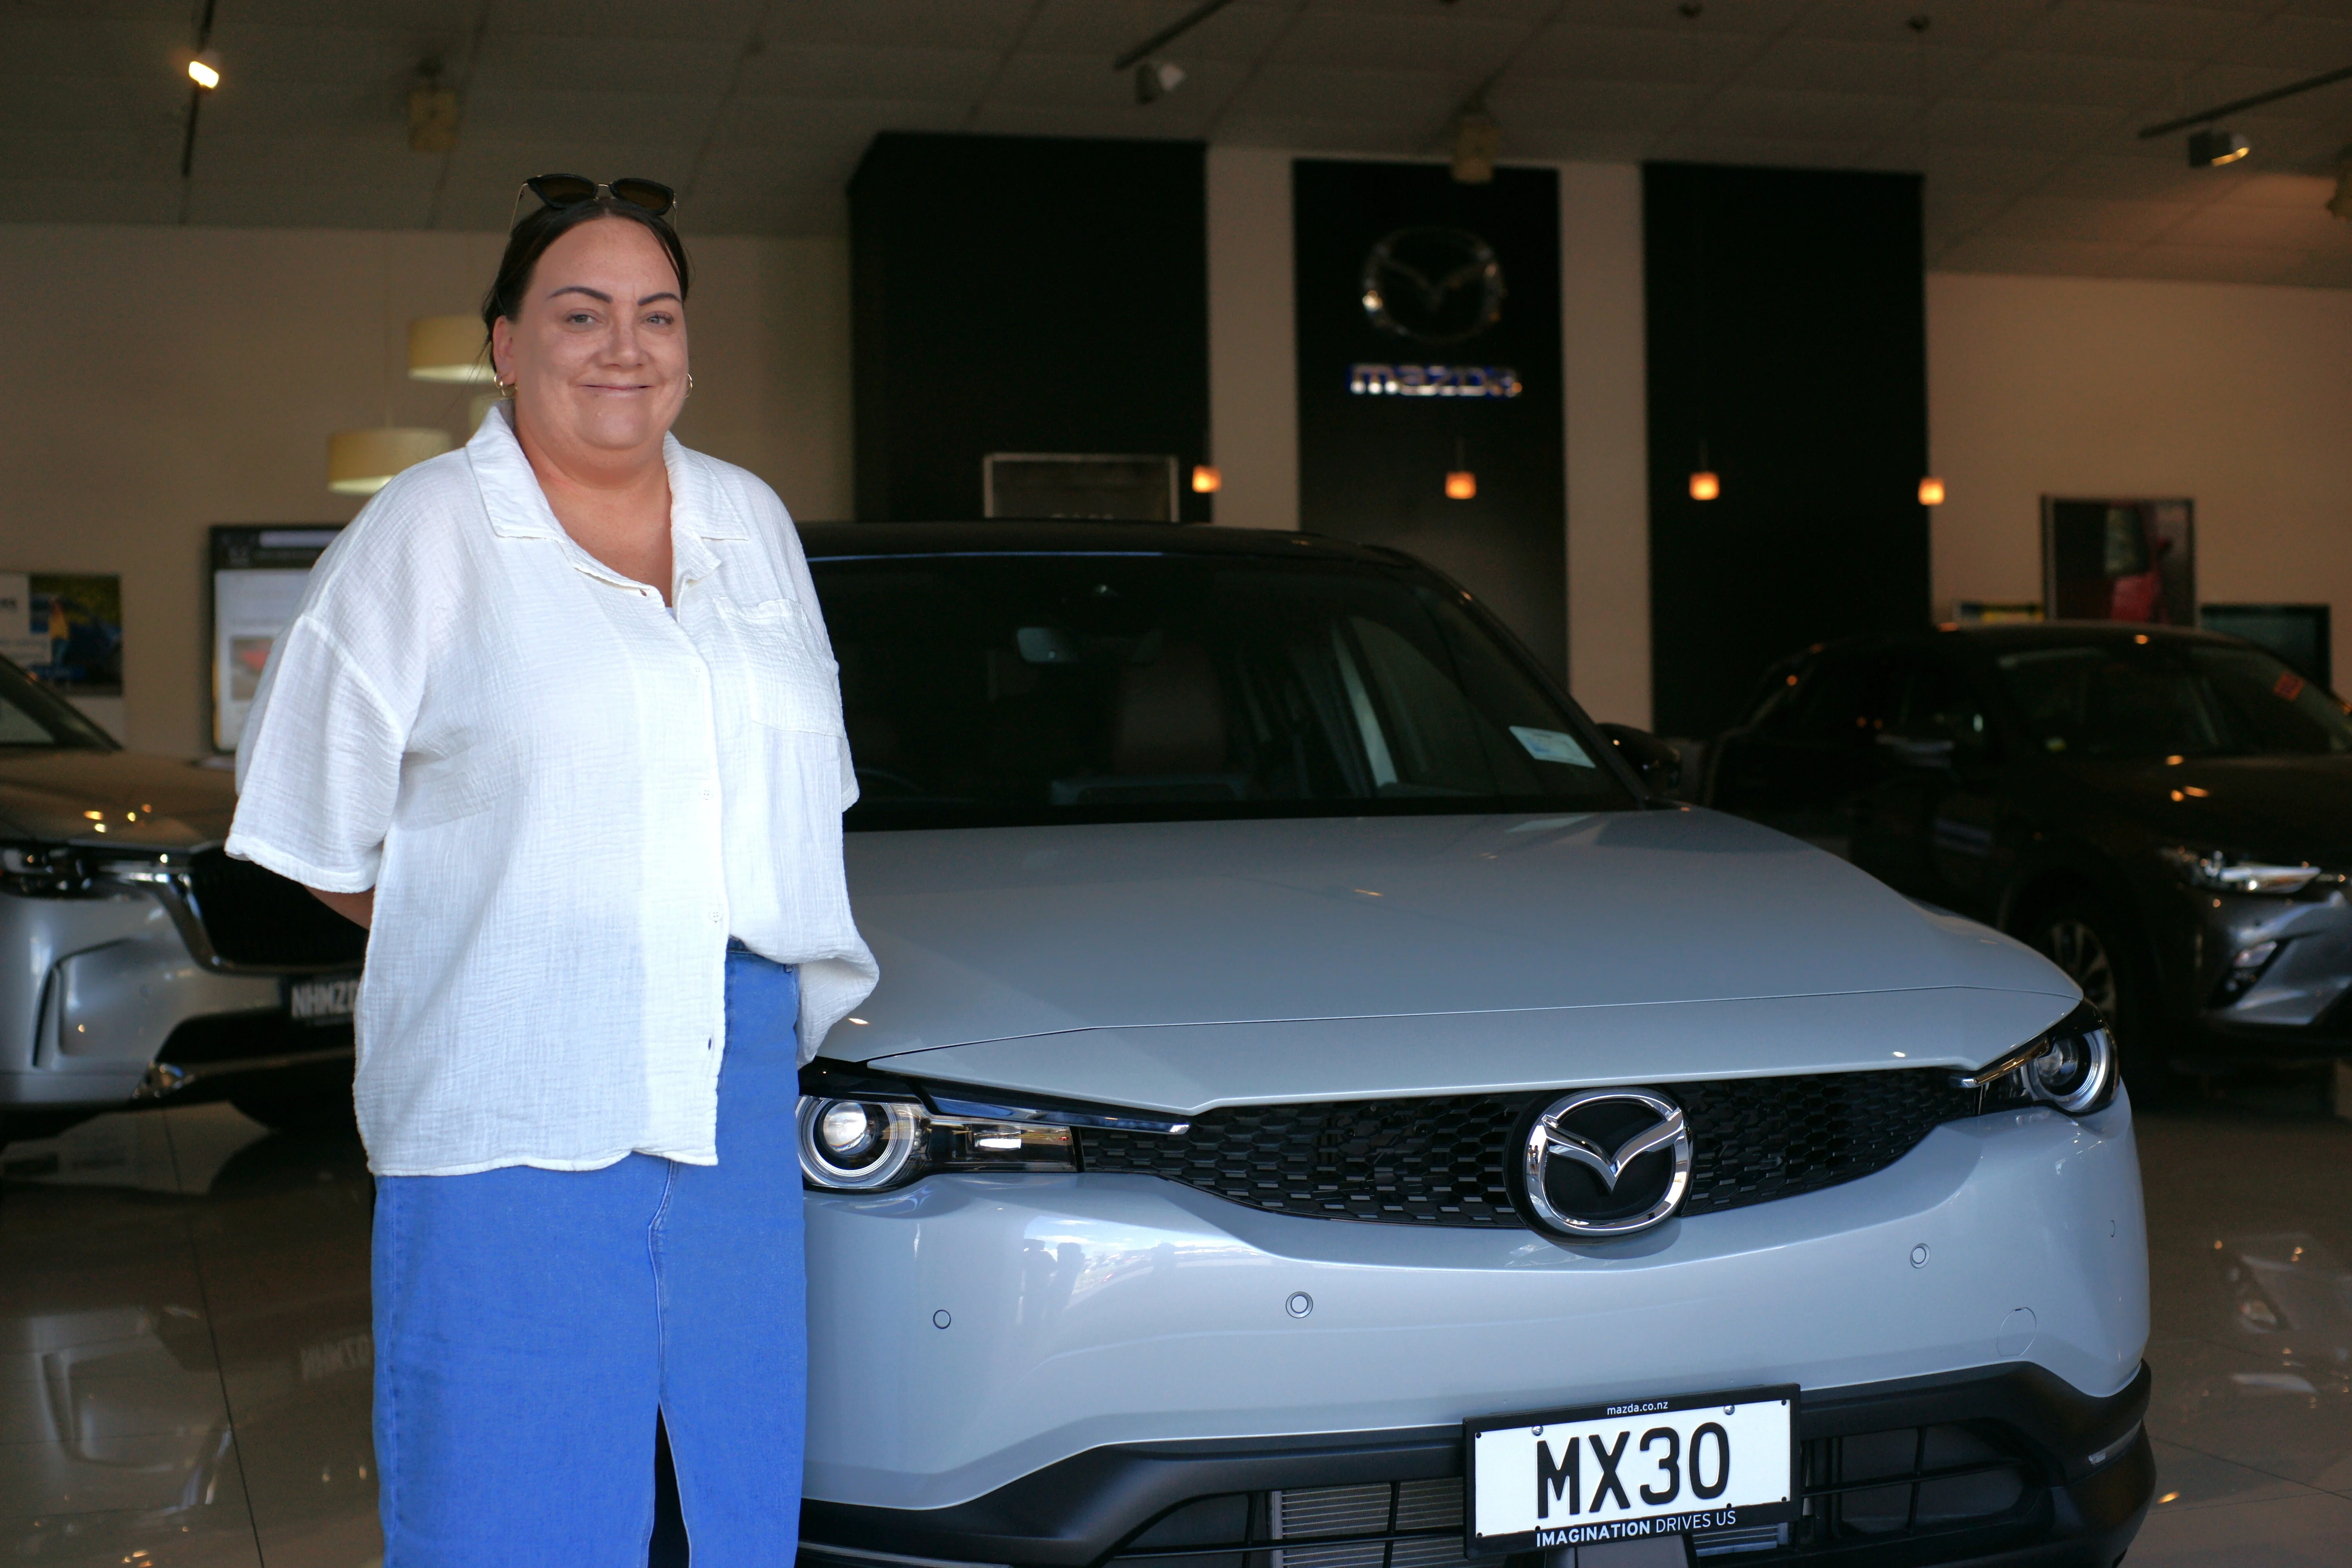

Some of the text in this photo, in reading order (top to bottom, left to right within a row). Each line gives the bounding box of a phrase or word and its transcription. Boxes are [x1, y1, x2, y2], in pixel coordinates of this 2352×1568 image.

[1607, 1401, 1668, 1416] mazda.co.nz
[1536, 1422, 1730, 1519] MX30
[1536, 1510, 1736, 1547] IMAGINATION DRIVES US
